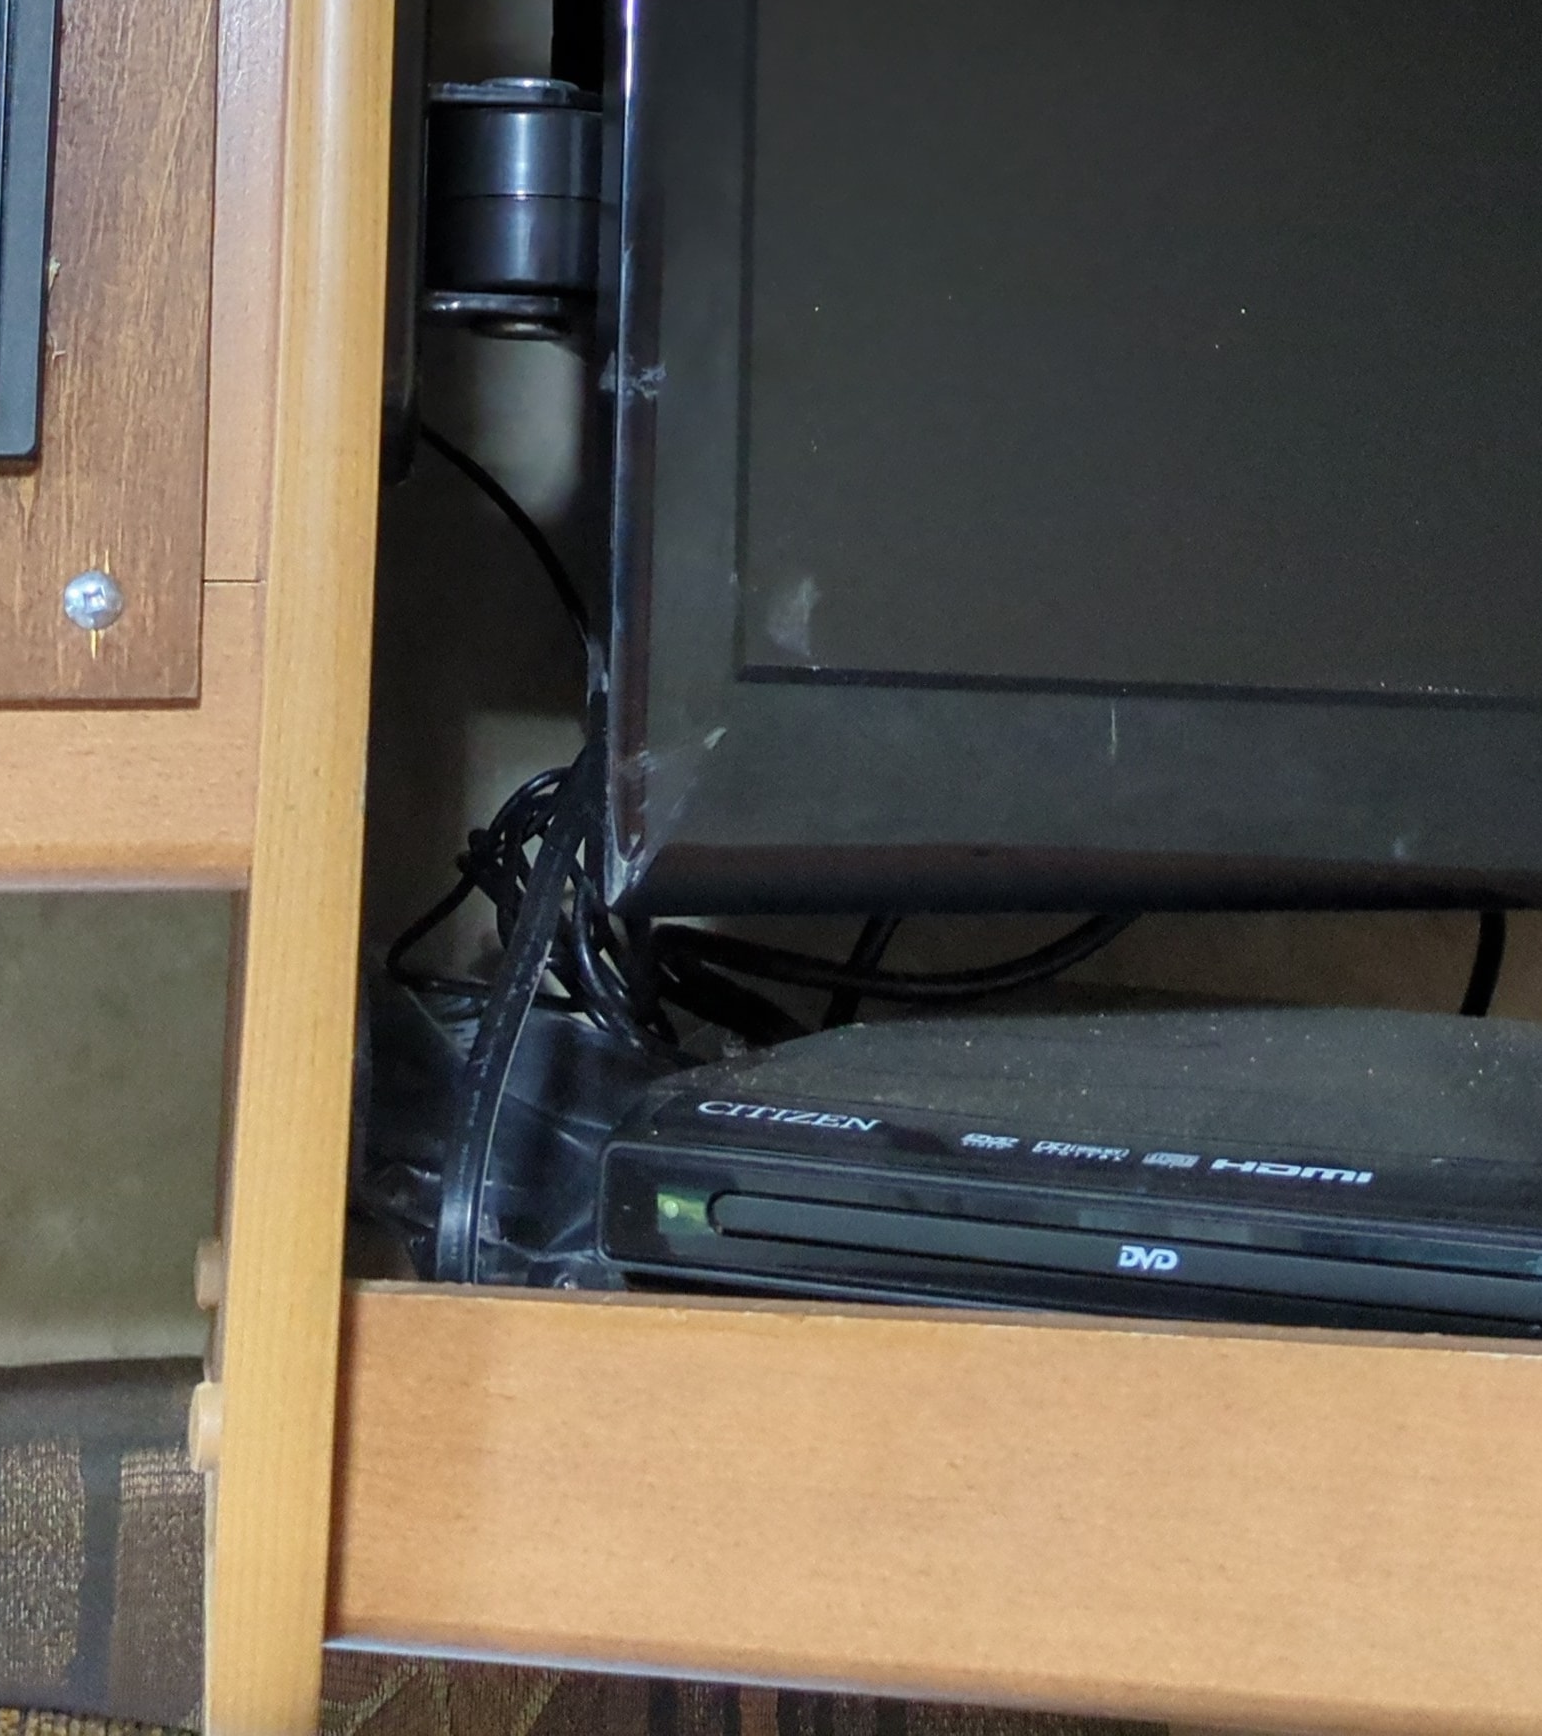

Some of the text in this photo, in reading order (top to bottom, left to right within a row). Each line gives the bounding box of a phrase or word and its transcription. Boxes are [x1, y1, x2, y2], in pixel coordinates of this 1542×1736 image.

[698, 1100, 881, 1132] CITIZEN
[1210, 1158, 1374, 1184] HDMI
[1118, 1244, 1179, 1272] DVD
